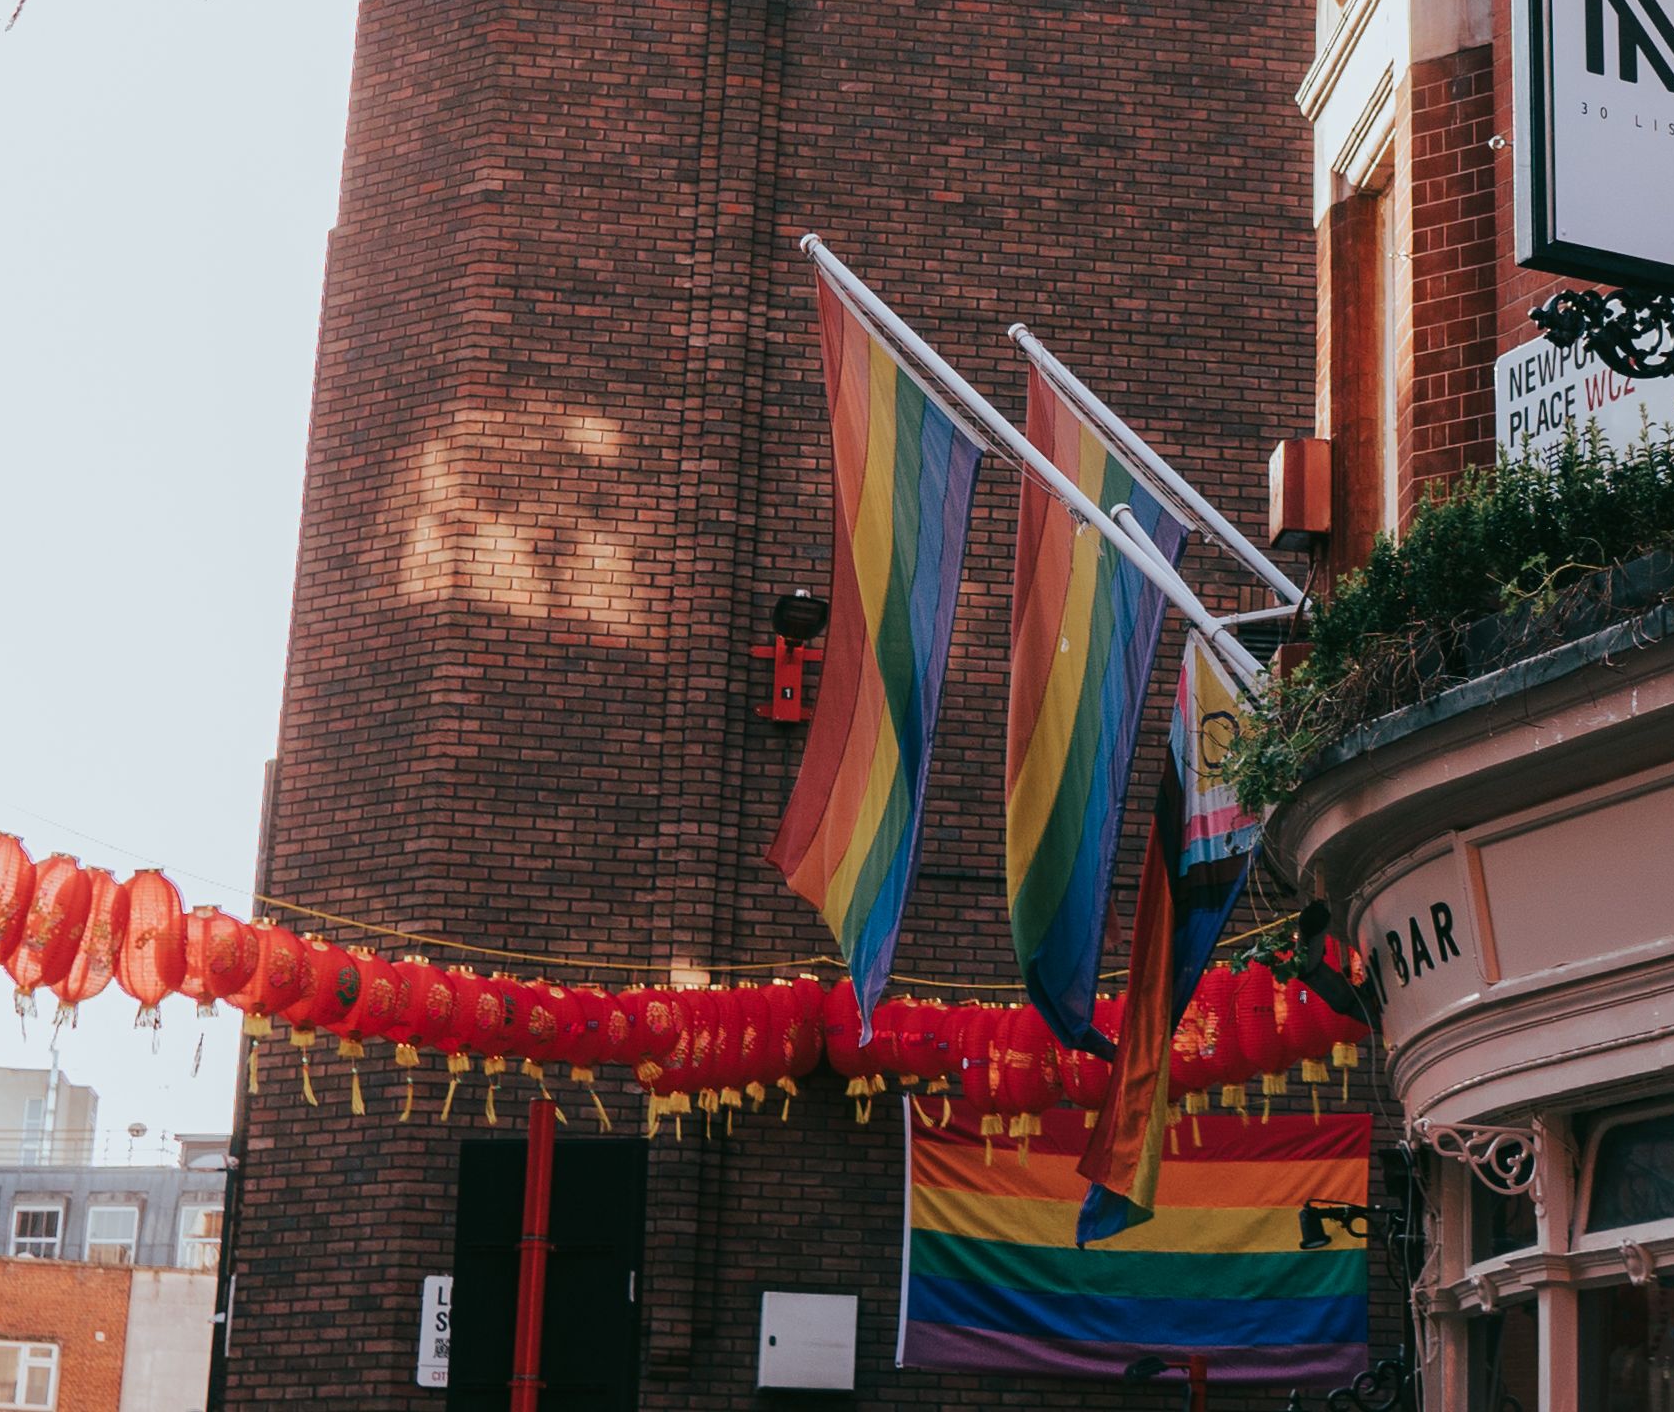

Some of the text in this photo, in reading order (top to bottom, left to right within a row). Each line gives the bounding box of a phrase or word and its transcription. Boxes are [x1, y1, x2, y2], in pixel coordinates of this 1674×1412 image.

[1580, 101, 1611, 120] 30
[1509, 384, 1576, 448] PLACE
[1385, 901, 1461, 988] BAR
